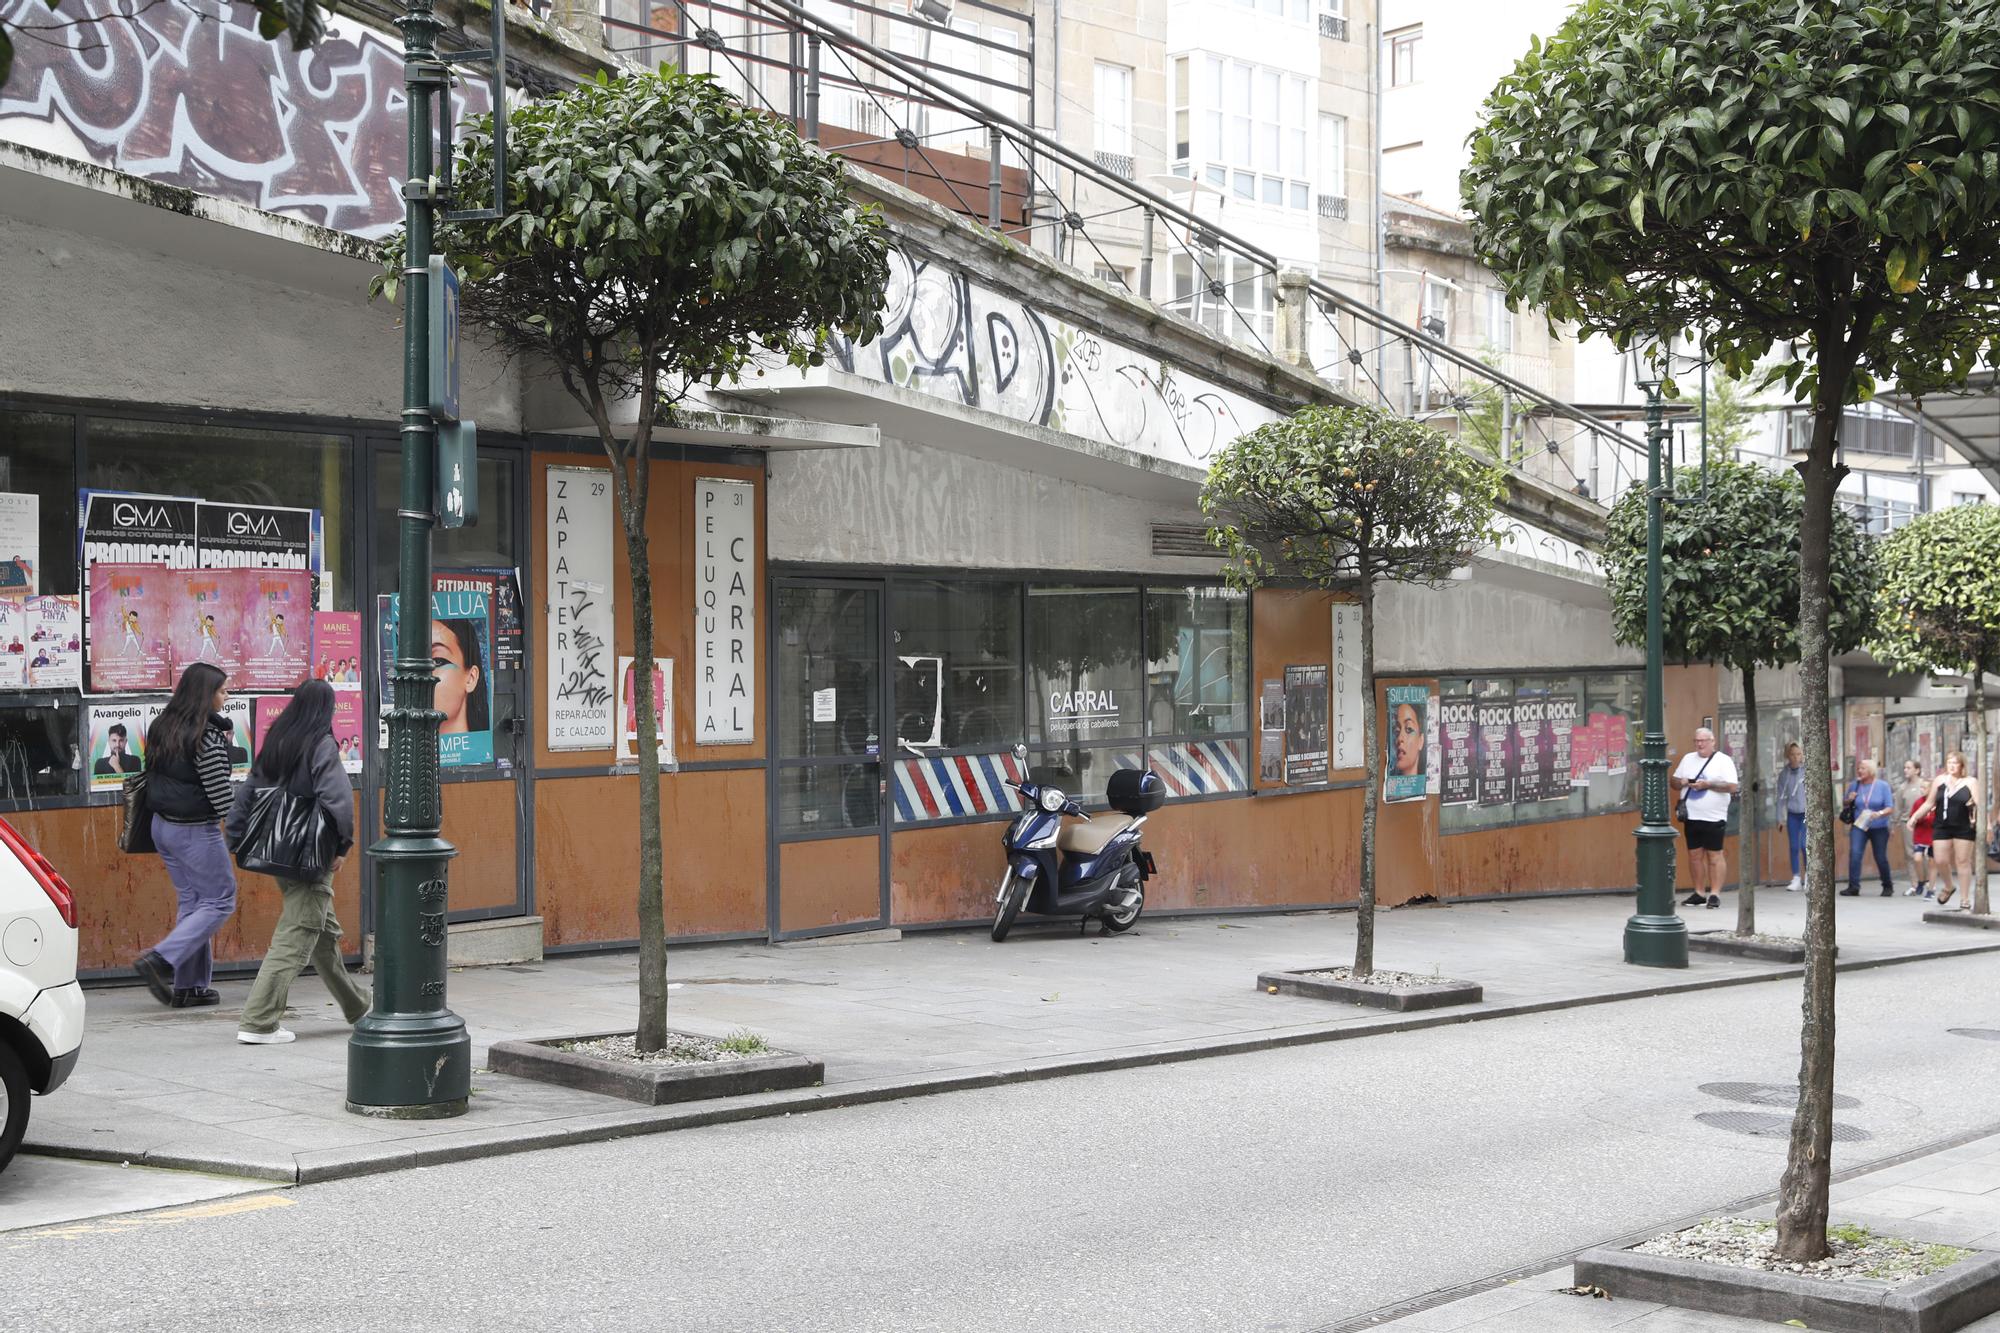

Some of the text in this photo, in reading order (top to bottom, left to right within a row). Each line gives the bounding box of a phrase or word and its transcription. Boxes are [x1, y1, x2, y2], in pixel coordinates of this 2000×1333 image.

[591, 483, 605, 496] 29
[733, 493, 744, 506] 31
[113, 503, 172, 528] IGMA
[227, 512, 281, 537] IGMA
[85, 529, 126, 537] CURSOS
[127, 531, 174, 539] OCTUBRE
[199, 536, 239, 545] CURSOS
[240, 538, 282, 547] OCTUBRE
[283, 541, 307, 549] 2022
[437, 579, 493, 595] FITIPALDIS
[555, 480, 569, 701] ZAPATERIA
[447, 594, 487, 616] LUA
[703, 491, 716, 733] PELUQUERIA
[1352, 611, 1360, 621] 33
[323, 623, 352, 632] MANEL
[729, 537, 746, 731] CARRAL
[1337, 611, 1345, 761] BARQUITOS
[334, 702, 353, 710] ANEL
[1050, 689, 1119, 713] CARRAL
[93, 708, 142, 720] Avangelio
[555, 709, 606, 720] REPARACION
[1441, 704, 1475, 723] ROCK
[1479, 708, 1512, 725] ROCK
[1513, 703, 1545, 722] ROCK
[1547, 702, 1577, 720] ROCK
[555, 725, 606, 737] DE CALZADO
[1091, 719, 1119, 729] caballeros
[440, 735, 471, 752] MPE
